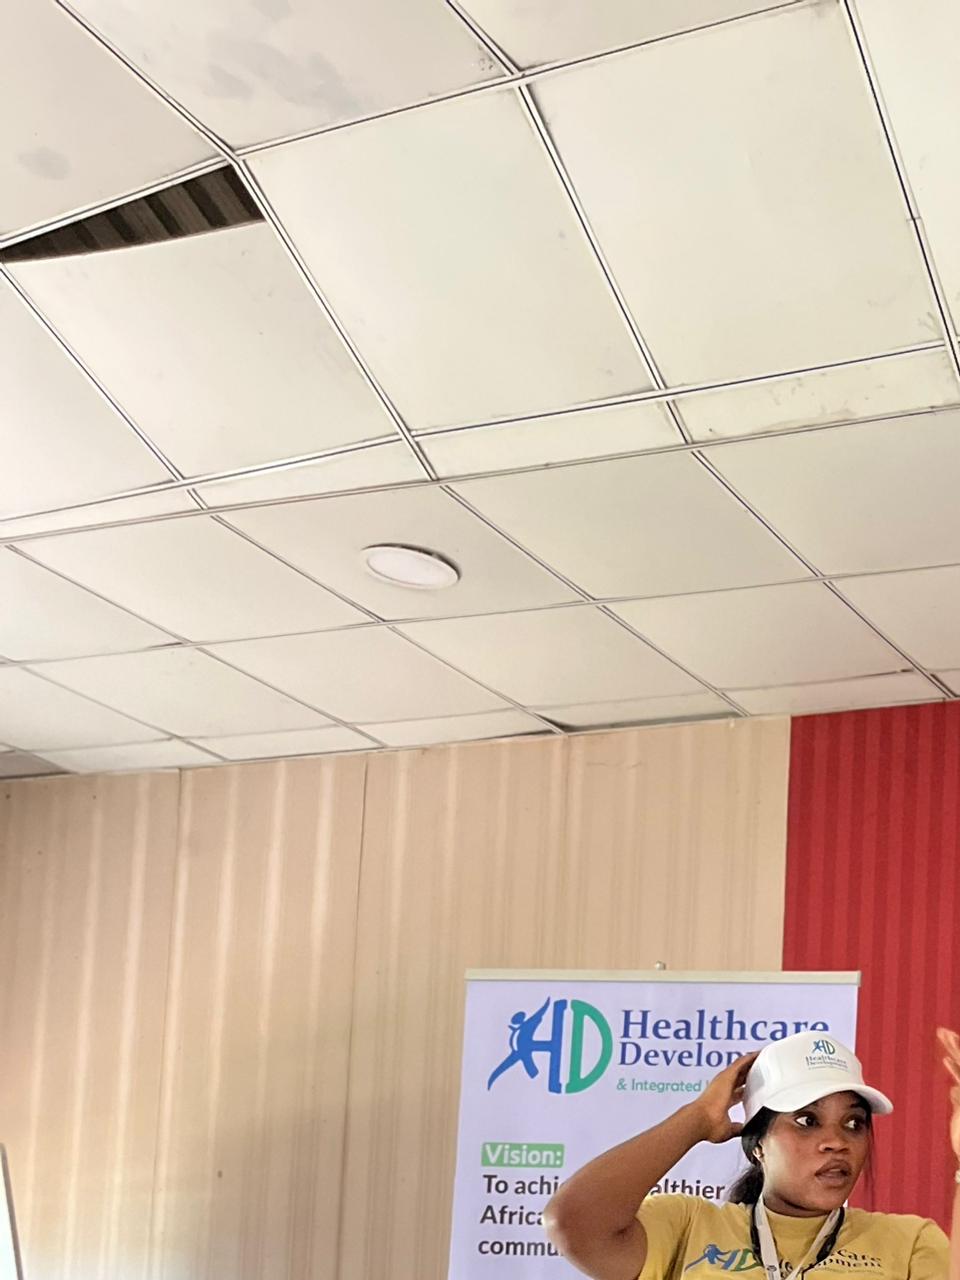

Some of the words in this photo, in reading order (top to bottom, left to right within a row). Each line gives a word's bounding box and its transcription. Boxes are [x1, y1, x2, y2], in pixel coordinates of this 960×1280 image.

[620, 1009, 829, 1042] Healthcare
[616, 1079, 627, 1091] &
[631, 1078, 702, 1093] Integrated
[484, 1144, 562, 1166] Vision:
[482, 1174, 509, 1194] To
[650, 1178, 726, 1200] althier
[477, 1240, 564, 1257] commu
